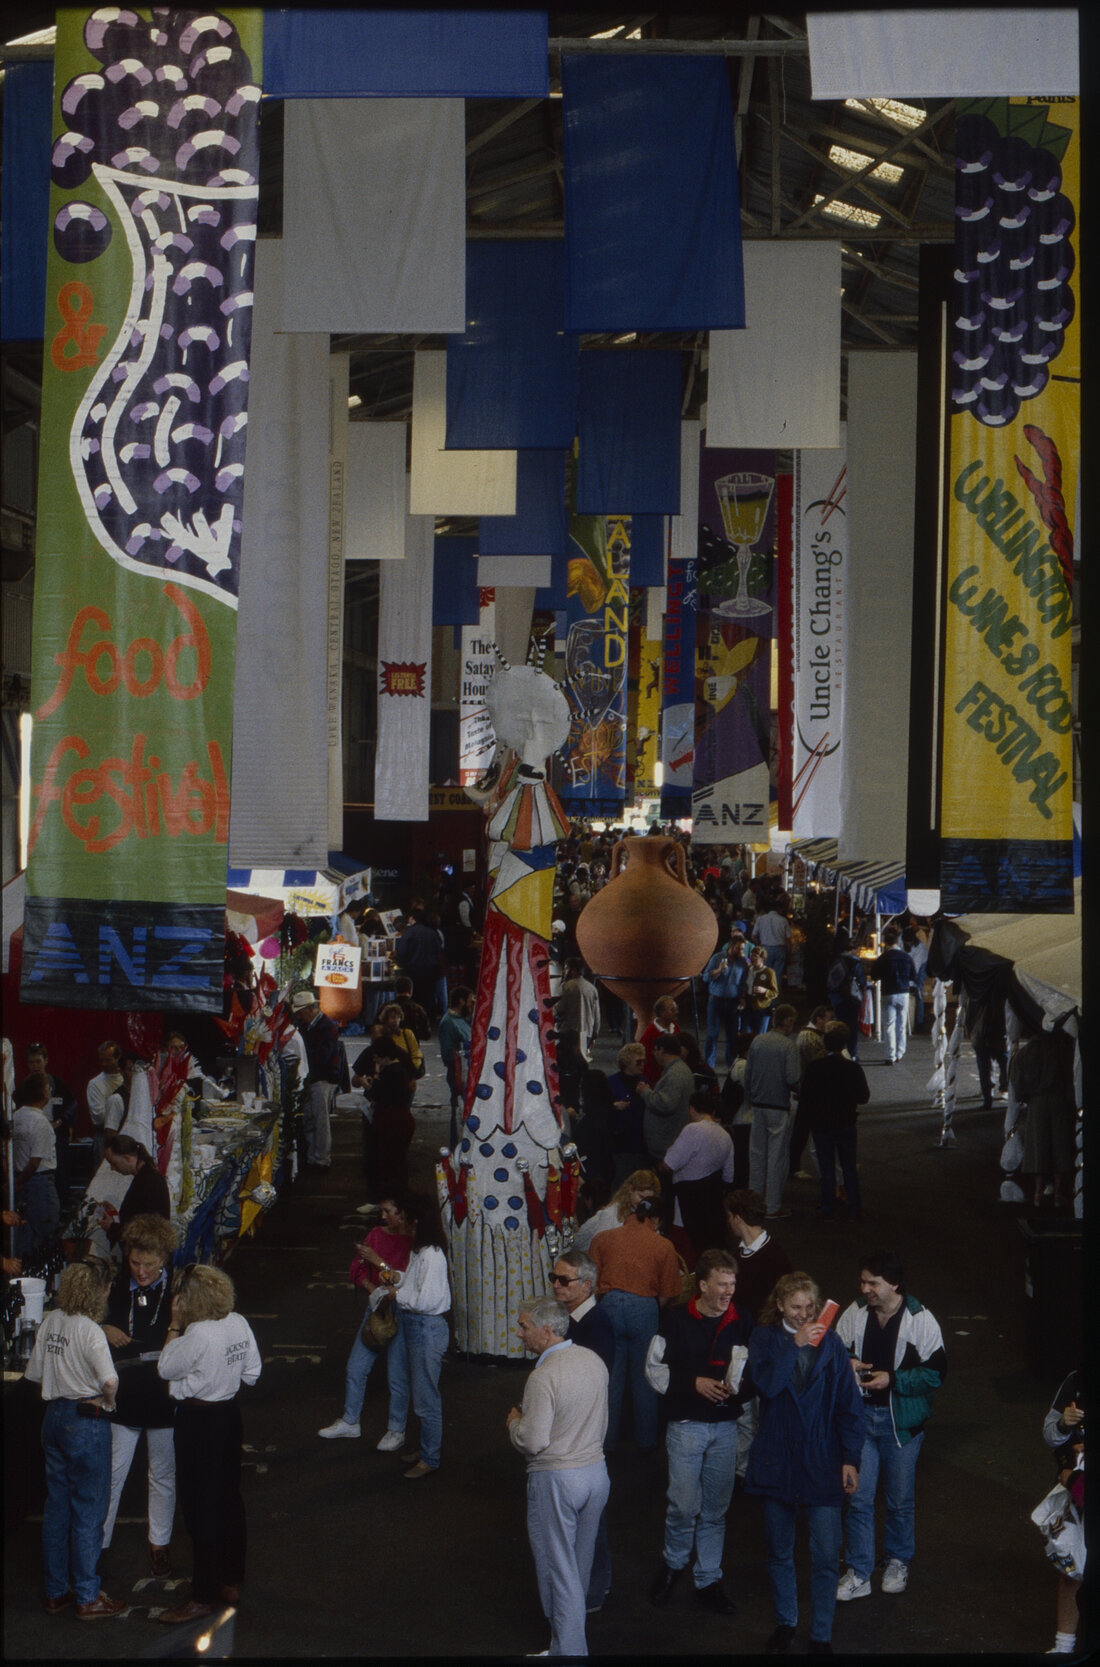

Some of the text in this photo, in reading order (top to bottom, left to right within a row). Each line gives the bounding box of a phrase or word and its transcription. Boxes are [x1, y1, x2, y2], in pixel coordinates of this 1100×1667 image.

[331, 461, 342, 513] ZEALAND
[331, 519, 341, 542] NEW
[955, 459, 1073, 639] WELLINGTON
[604, 515, 633, 668] ALAND
[329, 601, 339, 650] CENTRAL
[471, 639, 491, 654] The
[663, 556, 685, 694] WELLINGT
[809, 531, 842, 722] Uncle Chang's
[835, 578, 843, 689] RESTAURANT
[950, 564, 1029, 658] WINE
[1018, 663, 1072, 734] FOOD
[391, 679, 417, 690] FREE
[463, 681, 488, 696] Hou
[465, 660, 495, 678] Satay
[955, 681, 1068, 819] FESTIVAL
[695, 803, 764, 825] ANZ
[947, 855, 1073, 896] ANZ
[29, 922, 213, 987] ANZ
[321, 959, 355, 967] FRANCS
